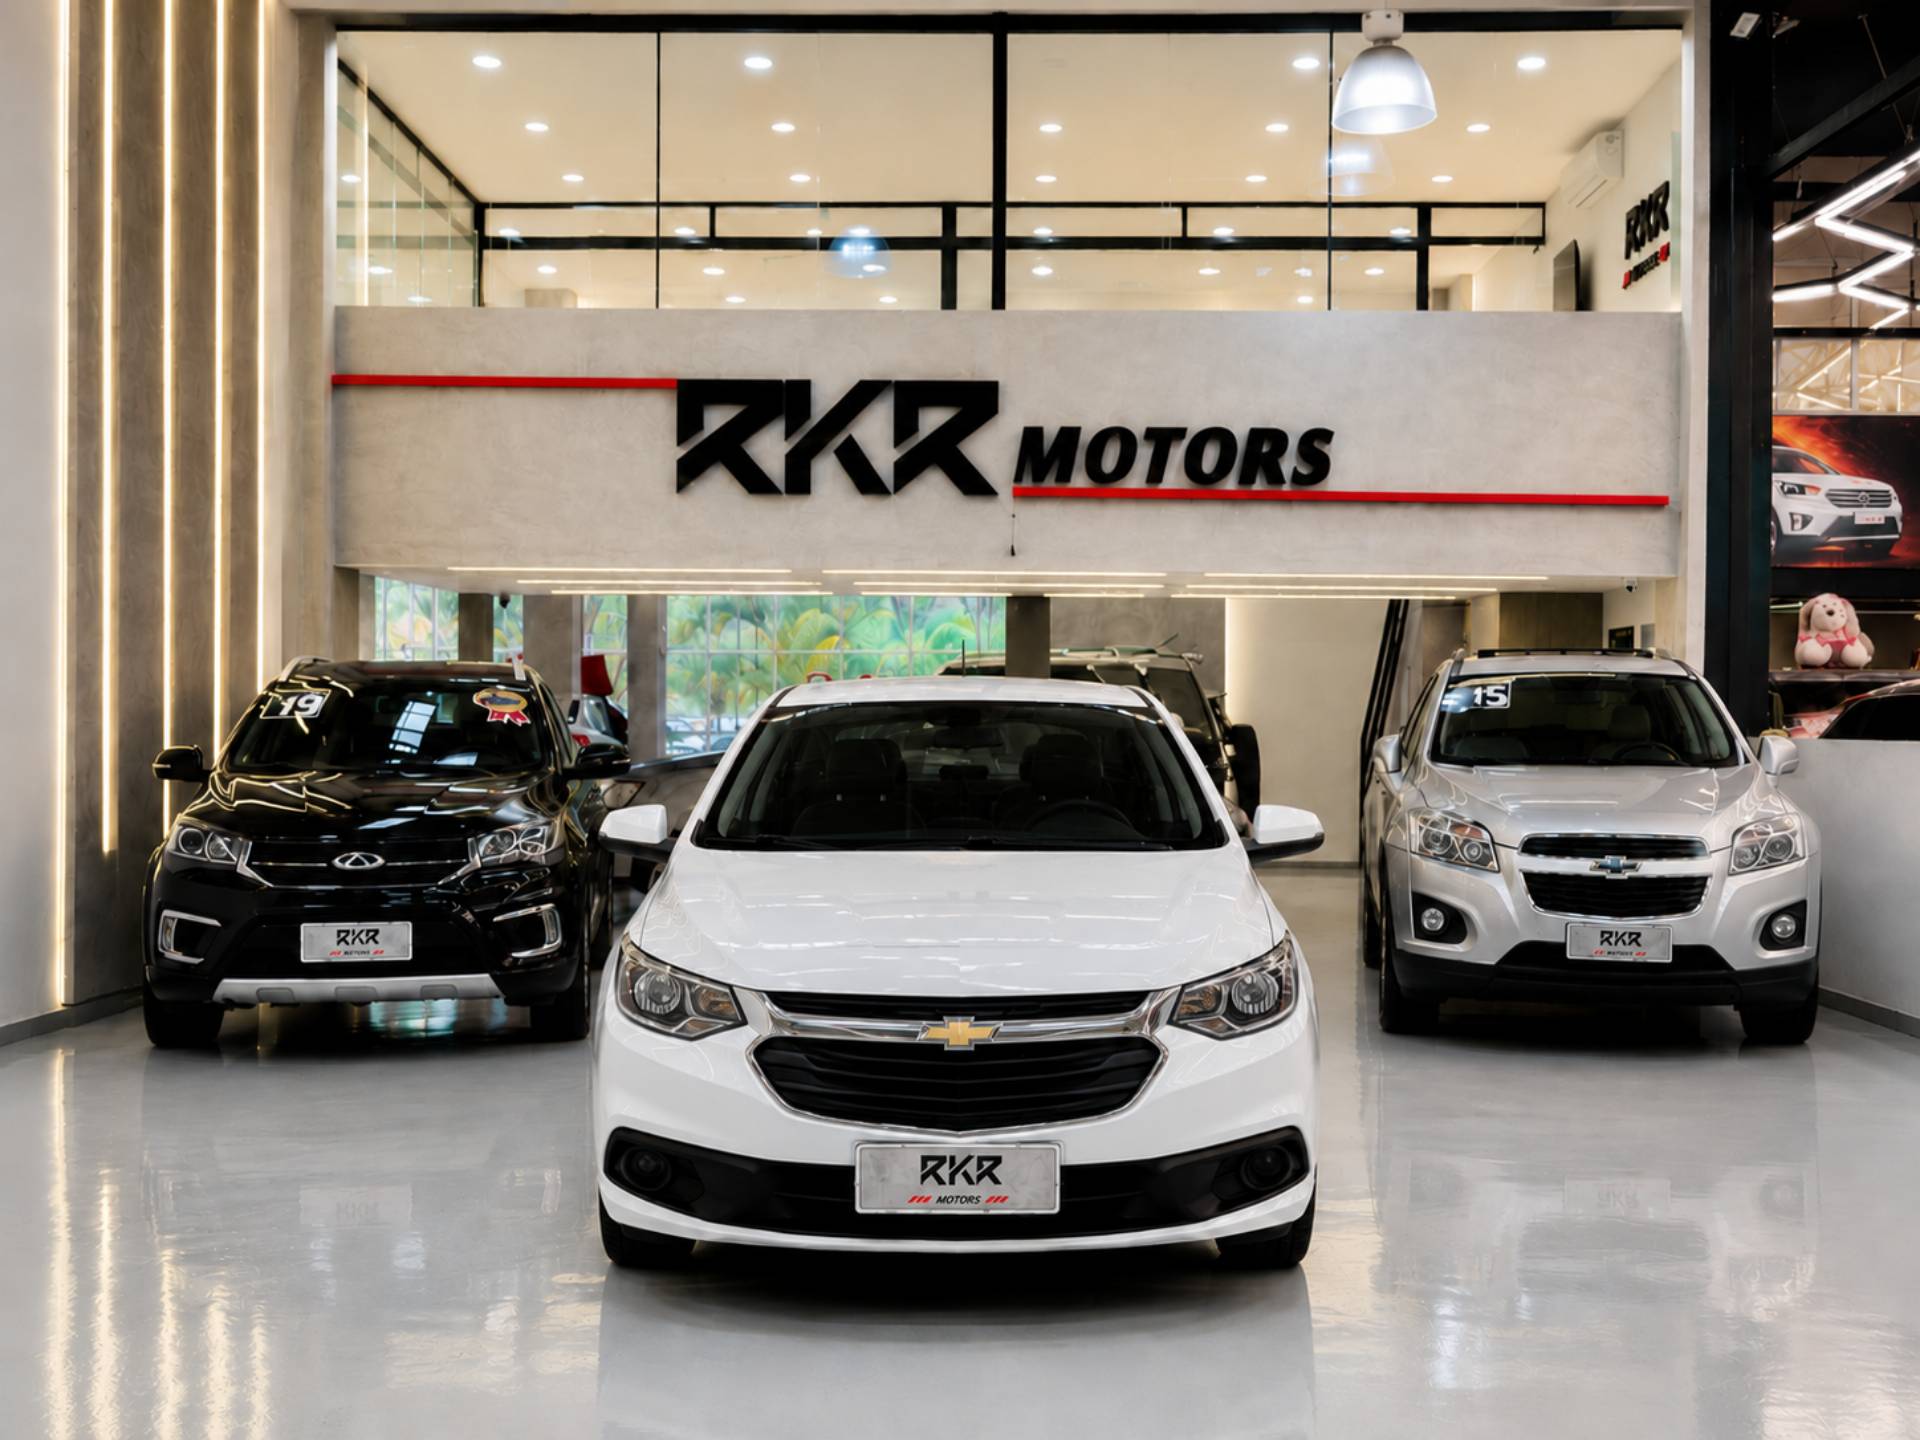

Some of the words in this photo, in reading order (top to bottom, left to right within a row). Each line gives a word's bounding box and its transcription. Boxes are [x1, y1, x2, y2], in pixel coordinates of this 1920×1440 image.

[1624, 180, 1670, 260] RKR
[676, 379, 999, 496] RKR
[1014, 425, 1335, 486] MOTORS
[279, 693, 323, 716] 19
[1473, 684, 1508, 707] 15
[336, 928, 380, 946] RKR
[1600, 930, 1642, 947] RKR
[920, 1154, 1002, 1186] RKR
[936, 1195, 981, 1205] MOTORS
